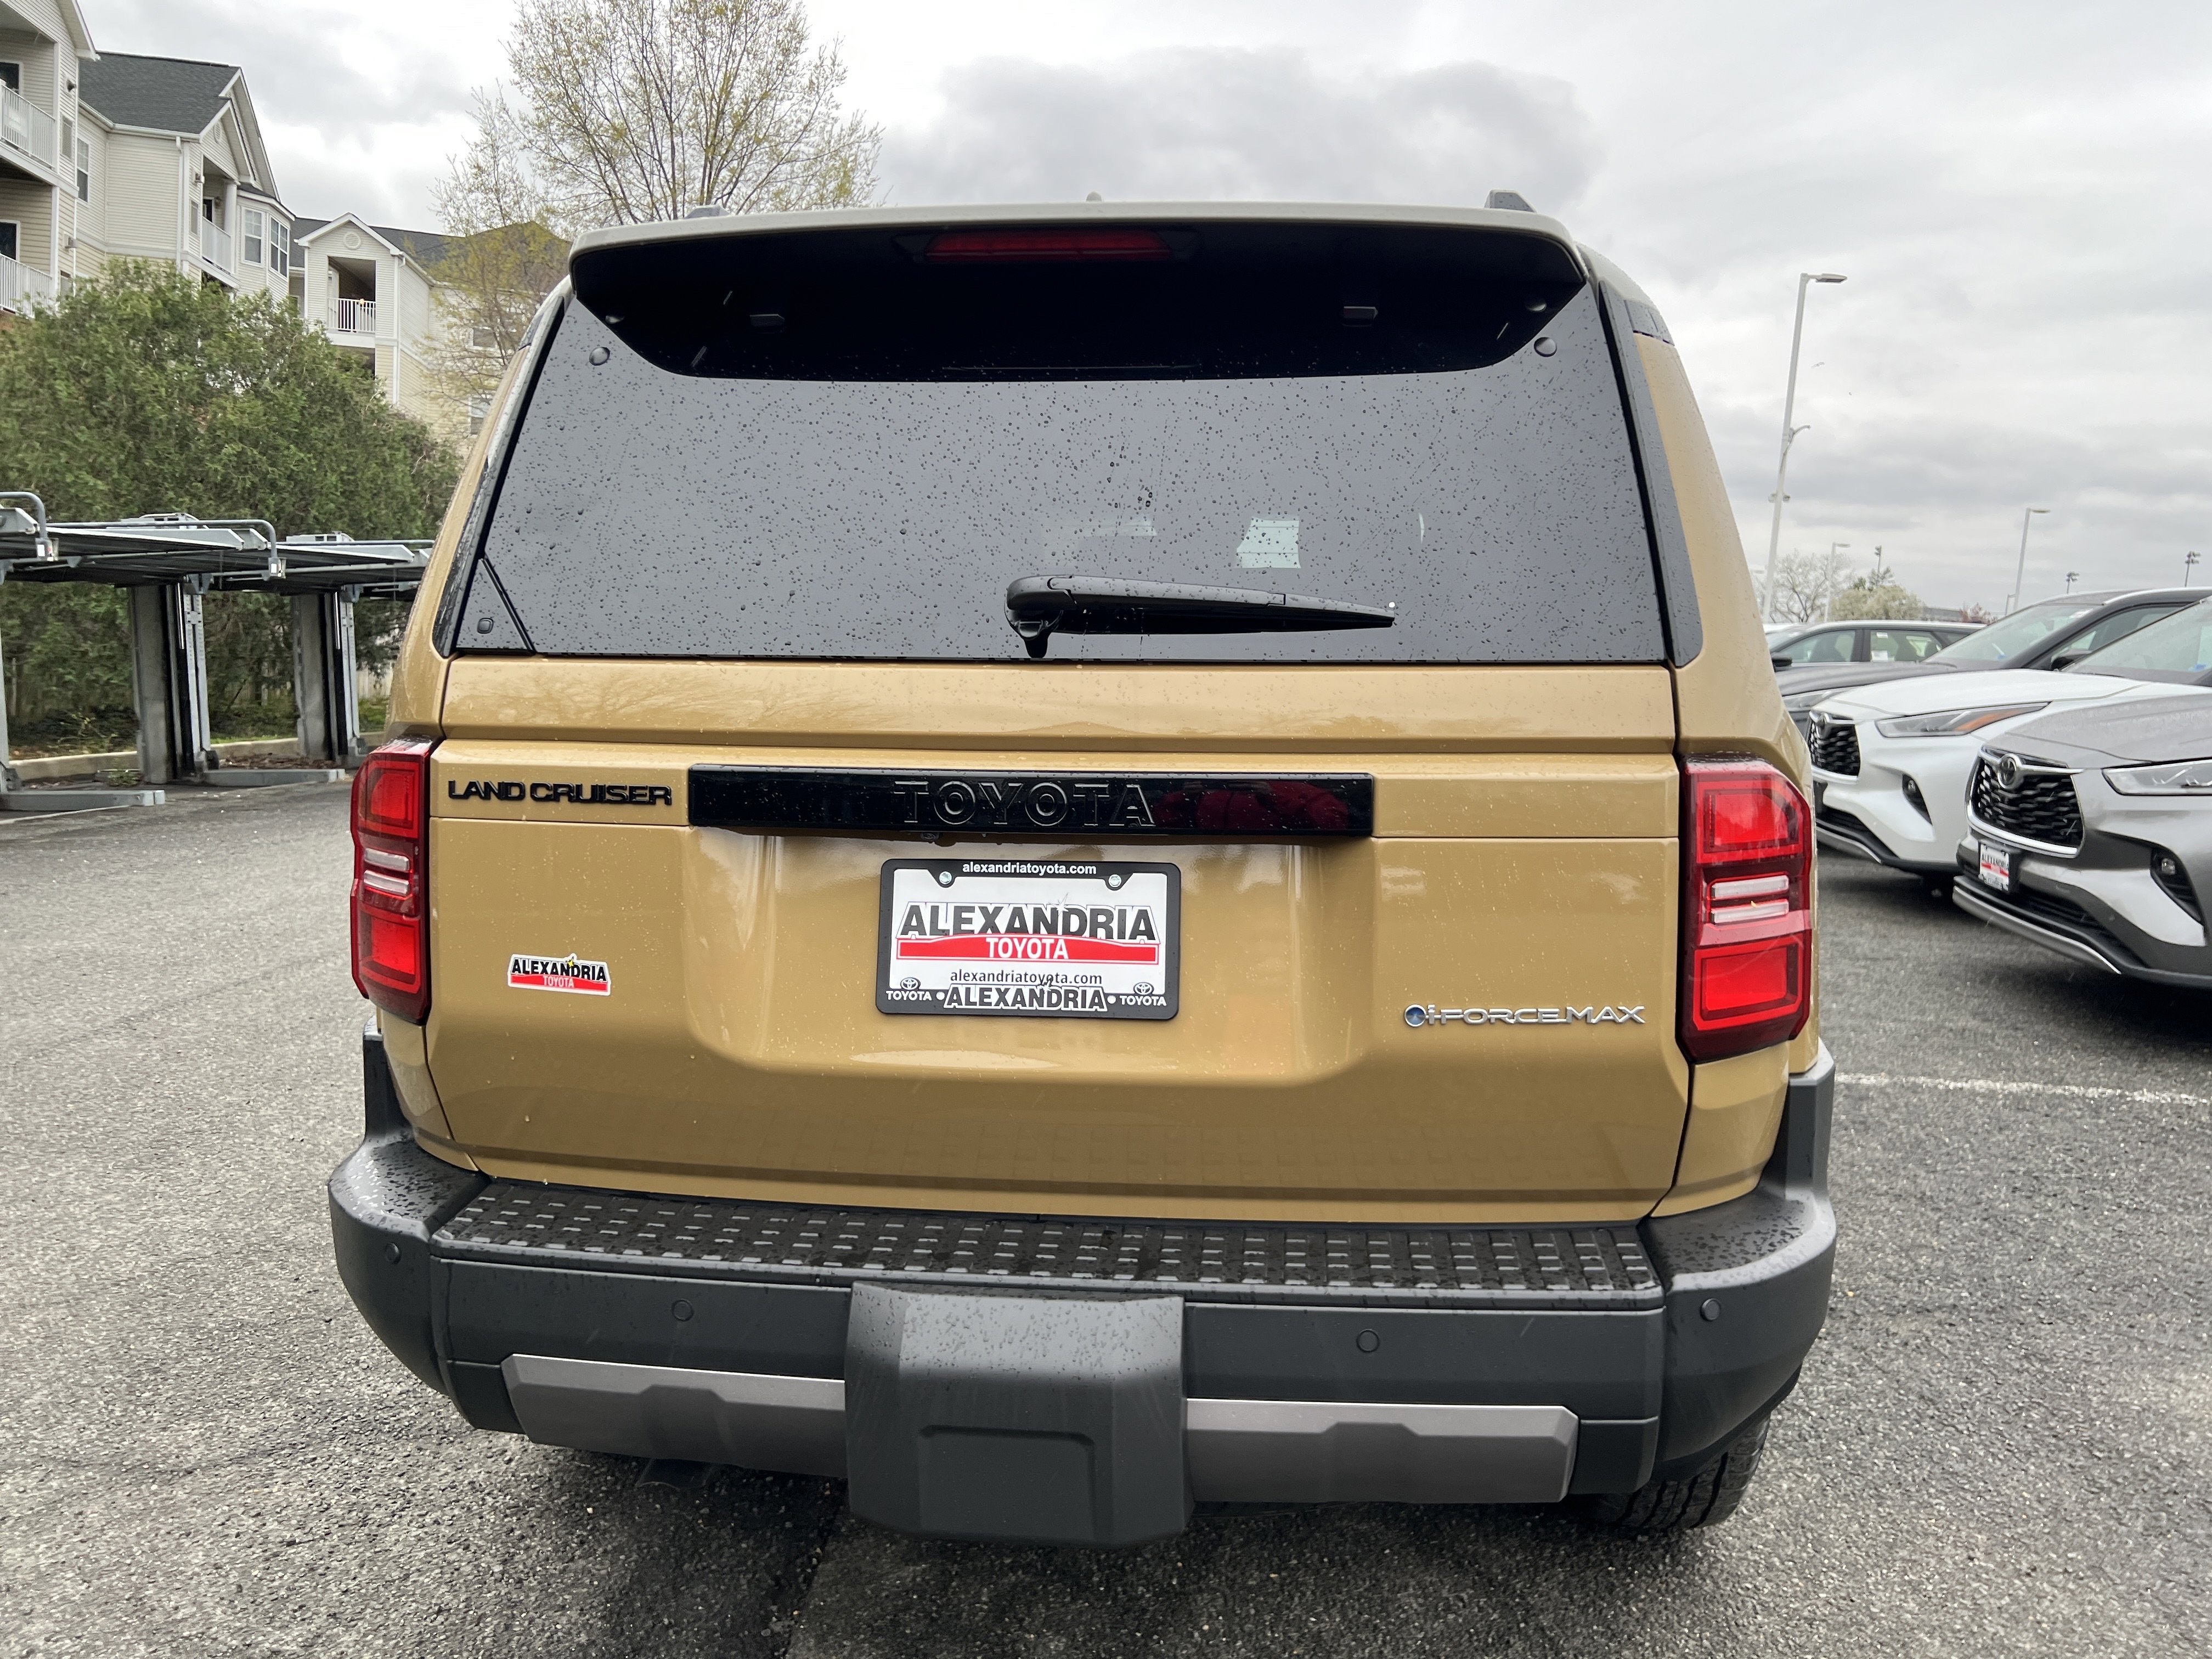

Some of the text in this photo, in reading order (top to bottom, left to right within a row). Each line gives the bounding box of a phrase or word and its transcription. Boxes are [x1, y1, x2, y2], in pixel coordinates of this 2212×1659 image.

[448, 780, 672, 805] LAND CRUISER
[893, 780, 1156, 826] TOYOTA
[962, 862, 1097, 876] alexandriatoyota.com
[900, 905, 1156, 940] ALEXANDRIA
[985, 937, 1069, 959] TOYOTA
[512, 959, 606, 981] ALEXANDRIA
[950, 969, 1103, 985] alexandriatoyota.com
[543, 975, 574, 988] TOYOTA
[886, 991, 932, 1001] TOYOTA
[946, 986, 1105, 1010] ALEXANDRIA
[1120, 995, 1167, 1006] TOYOTA
